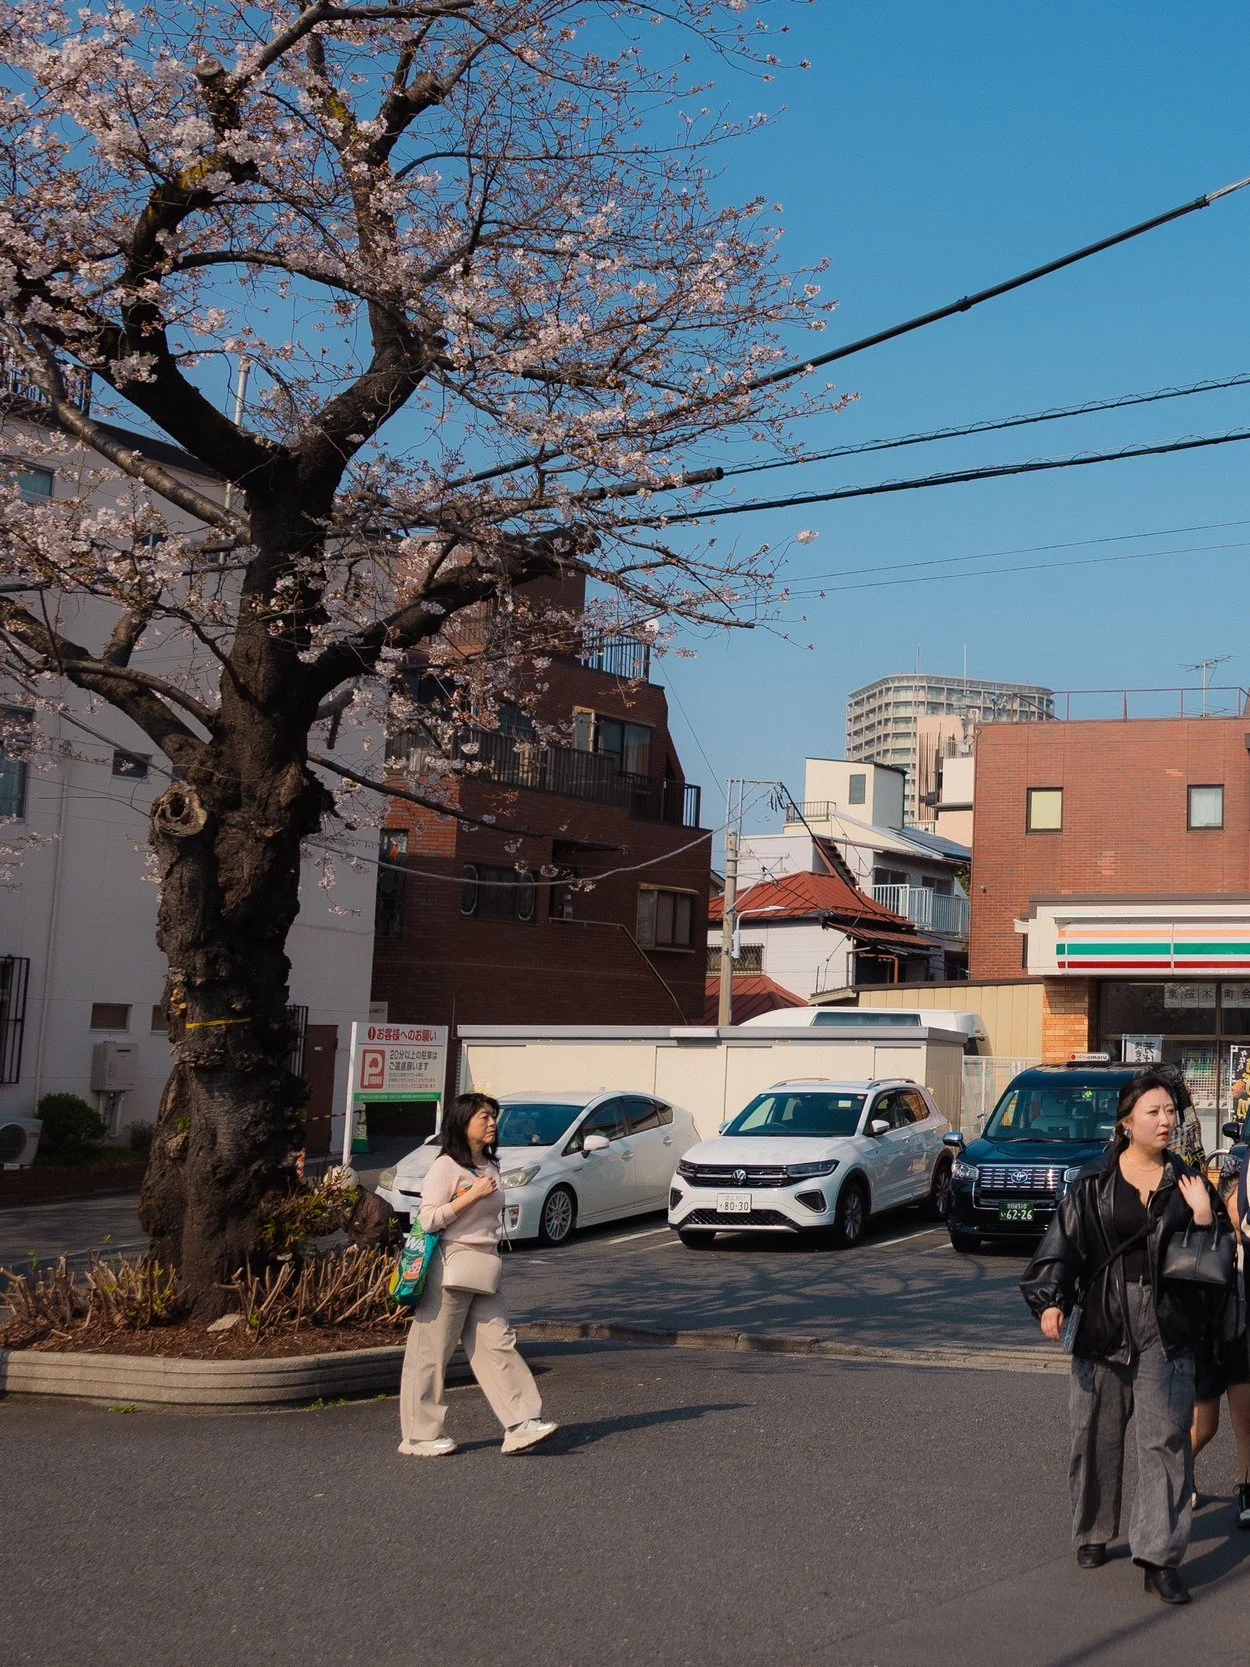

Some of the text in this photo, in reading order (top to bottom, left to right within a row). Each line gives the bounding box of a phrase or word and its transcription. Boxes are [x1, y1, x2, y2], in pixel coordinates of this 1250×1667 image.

[376, 1028, 437, 1042] お客様へのお願い
[389, 1049, 438, 1060] 20分以上の駐車は
[1006, 1209, 1033, 1220] 62-26
